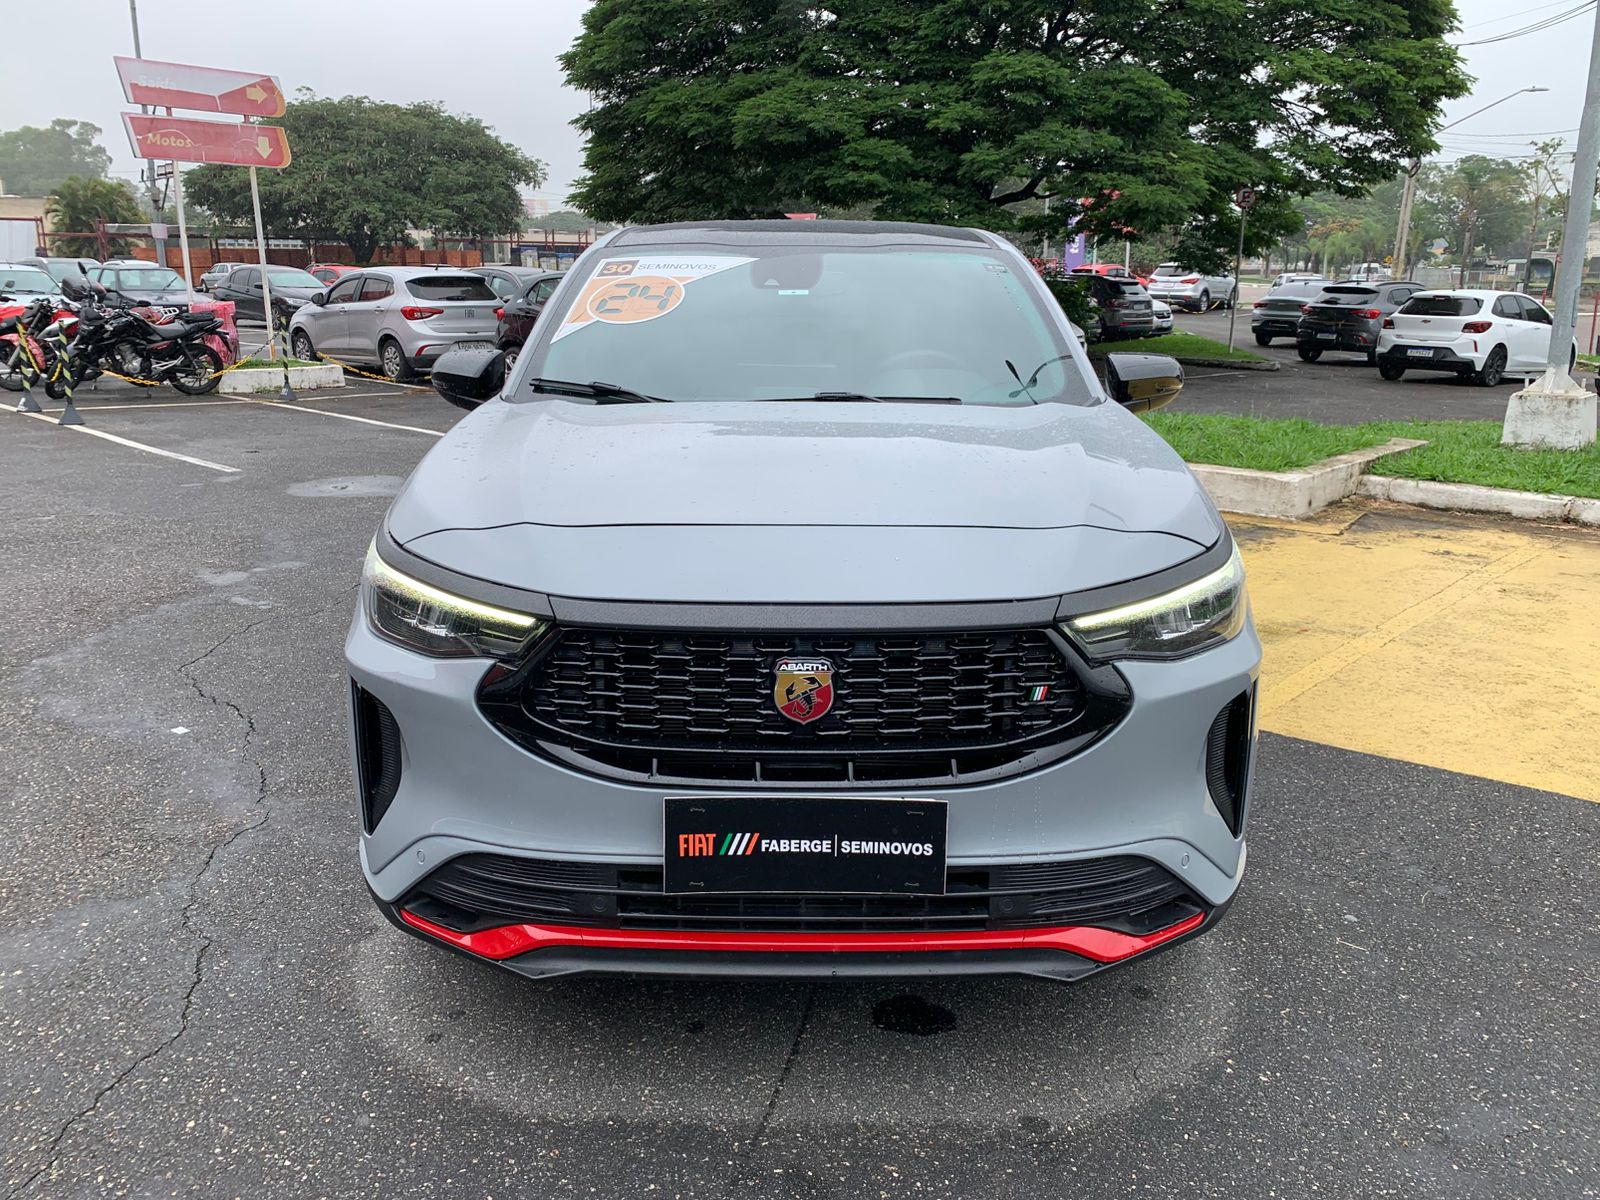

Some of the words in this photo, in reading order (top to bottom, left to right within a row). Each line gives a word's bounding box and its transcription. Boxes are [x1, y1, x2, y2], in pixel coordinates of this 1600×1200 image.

[147, 133, 192, 148] Motos
[602, 264, 633, 274] 30
[596, 283, 675, 313] 24
[780, 663, 828, 671] ABARTH
[679, 833, 716, 857] FIAT
[760, 839, 832, 853] FABERGE
[841, 840, 933, 856] SEMINOVOS
